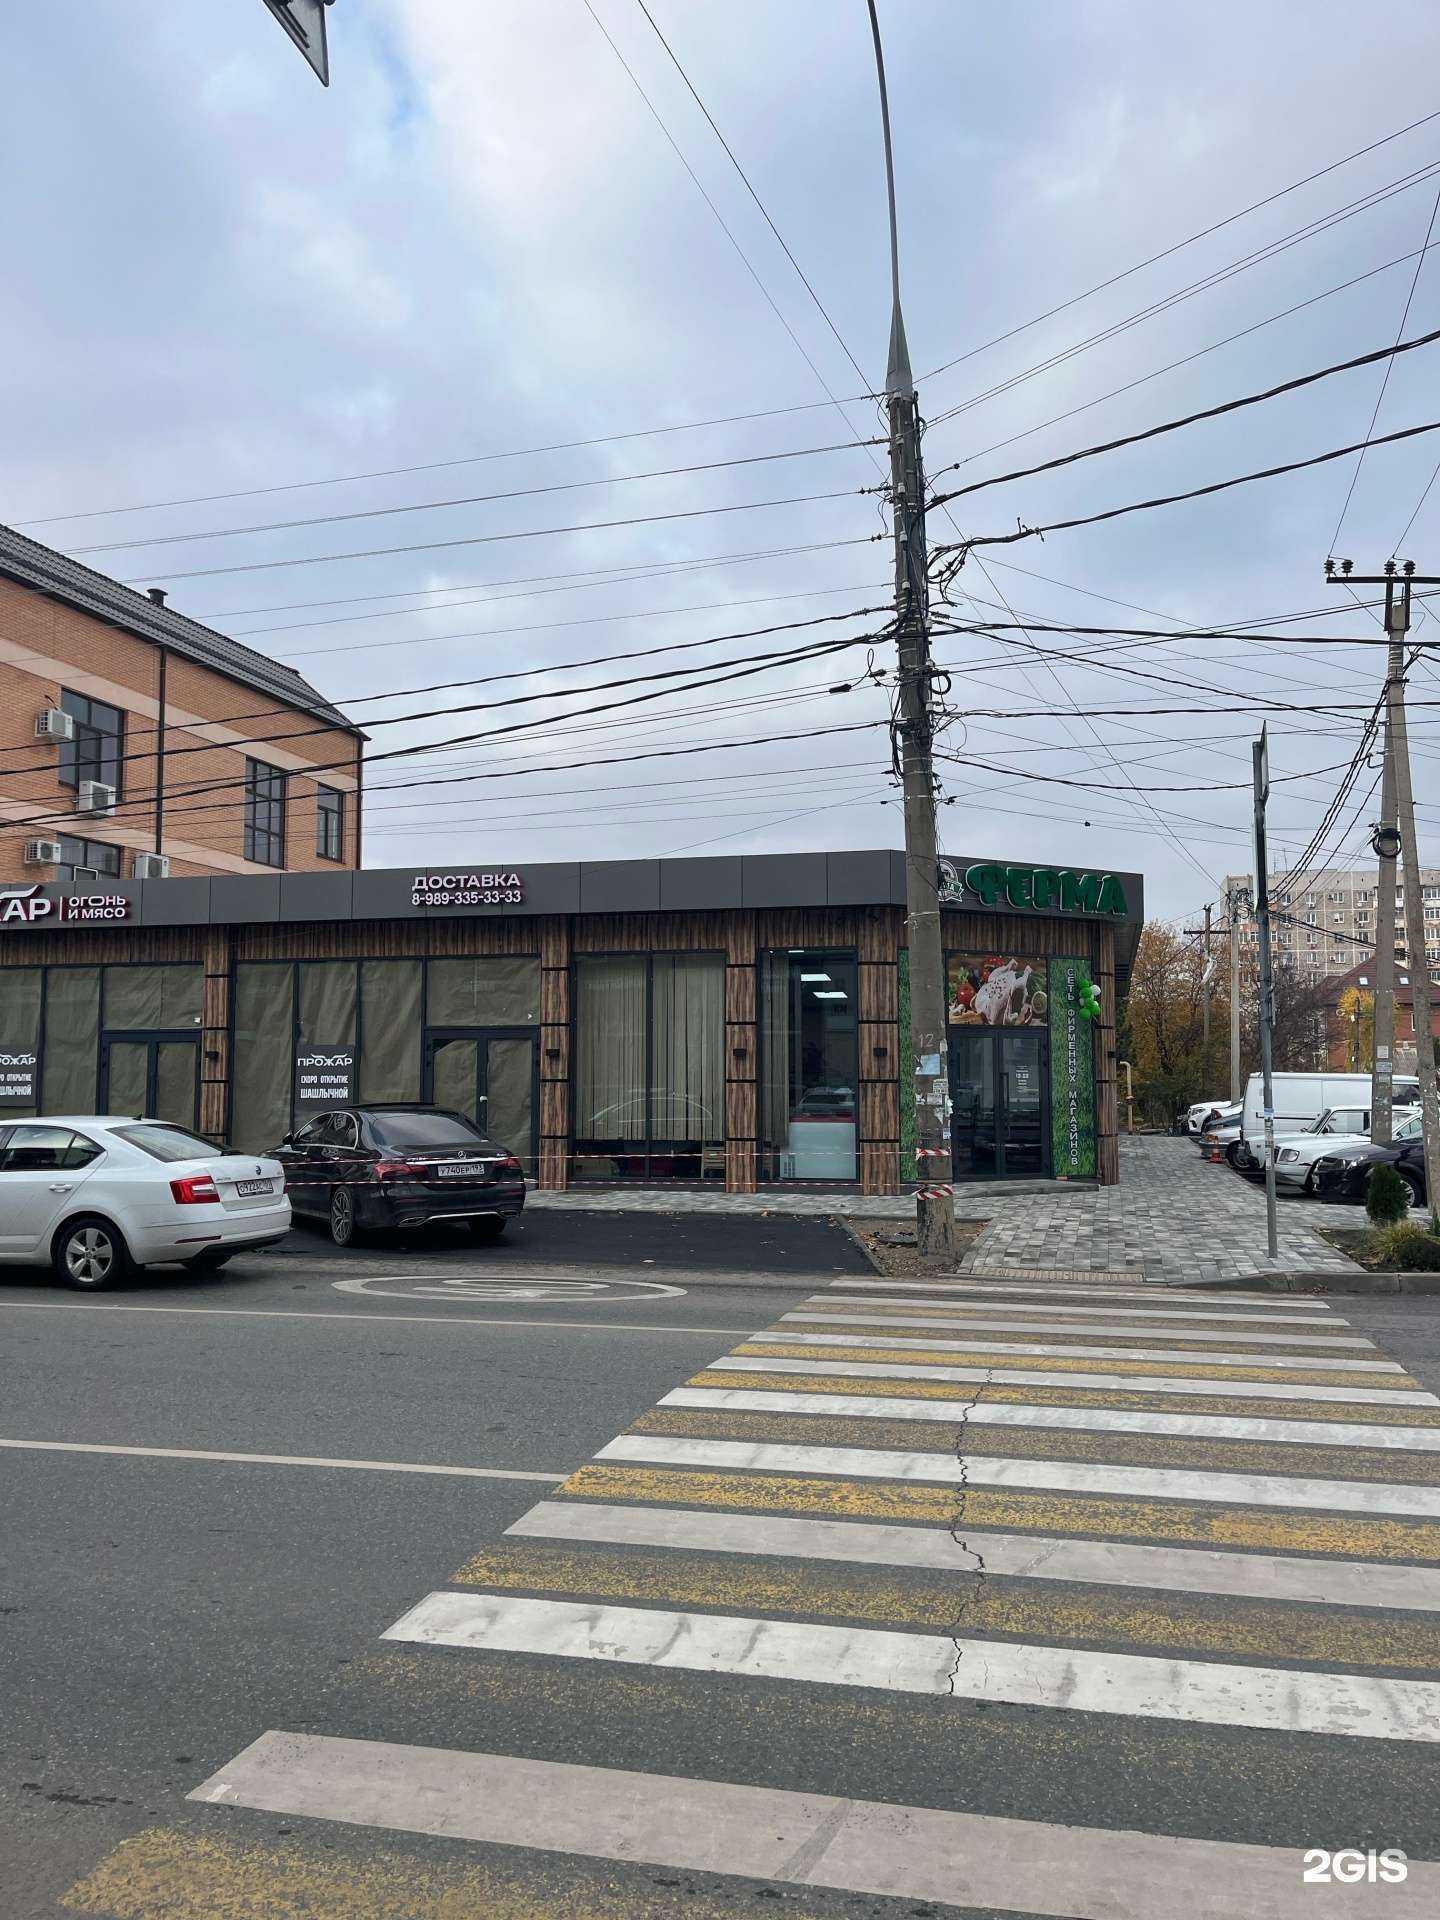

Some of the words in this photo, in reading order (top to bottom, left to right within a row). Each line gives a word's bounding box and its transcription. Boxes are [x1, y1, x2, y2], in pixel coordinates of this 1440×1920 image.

[411, 873, 521, 891] ДОСТАВКА
[965, 863, 1127, 916] ФЕРМА
[0, 885, 51, 921] АР
[69, 895, 126, 907] ОГОНЬ
[411, 890, 521, 905] 8-989-335-33-33
[68, 909, 78, 919] И
[81, 907, 125, 919] МЯСО
[1067, 968, 1075, 1001] СЕТЬ
[1067, 1008, 1077, 1082] ФИРМЕННЫХ
[297, 1053, 353, 1067] ПРОЖАР
[301, 1086, 348, 1099] ШАШЛЫЧНОЙ
[1068, 1090, 1079, 1166] МАГАЗИНОВ
